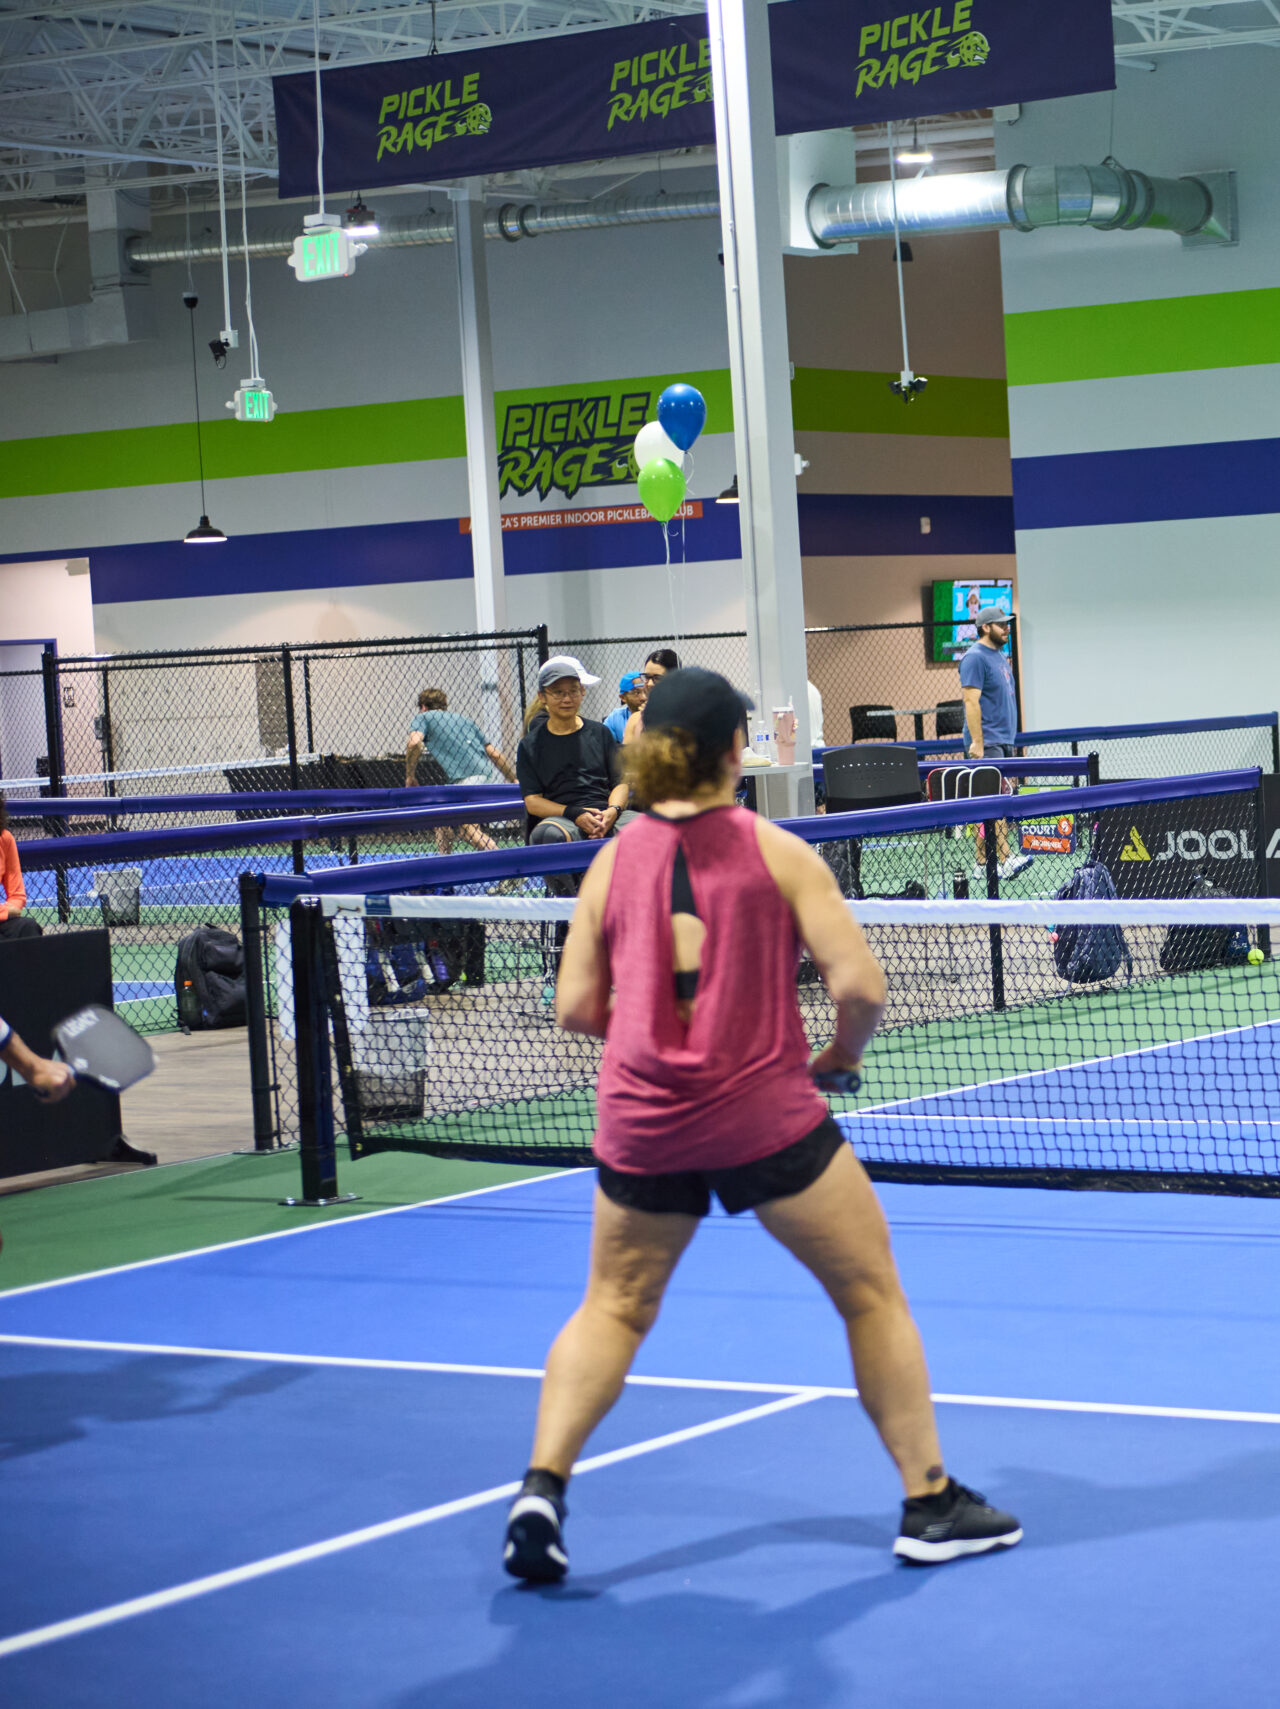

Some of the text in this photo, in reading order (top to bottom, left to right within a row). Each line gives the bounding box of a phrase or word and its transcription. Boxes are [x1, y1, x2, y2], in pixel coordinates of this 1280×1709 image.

[858, 0, 973, 58] PICKLE
[610, 38, 710, 92] PICKLE
[853, 39, 950, 99] RAGE
[378, 72, 480, 124] PICKLE
[606, 74, 697, 132] RAGE
[376, 109, 460, 163] RAGE
[302, 232, 340, 277] EXIT
[245, 391, 270, 420] EXIT
[502, 392, 651, 450] PICKLE
[498, 442, 616, 502] RAGE
[520, 511, 562, 528] PREMIER
[564, 511, 605, 524] INDOOR
[1021, 824, 1057, 835] COURT
